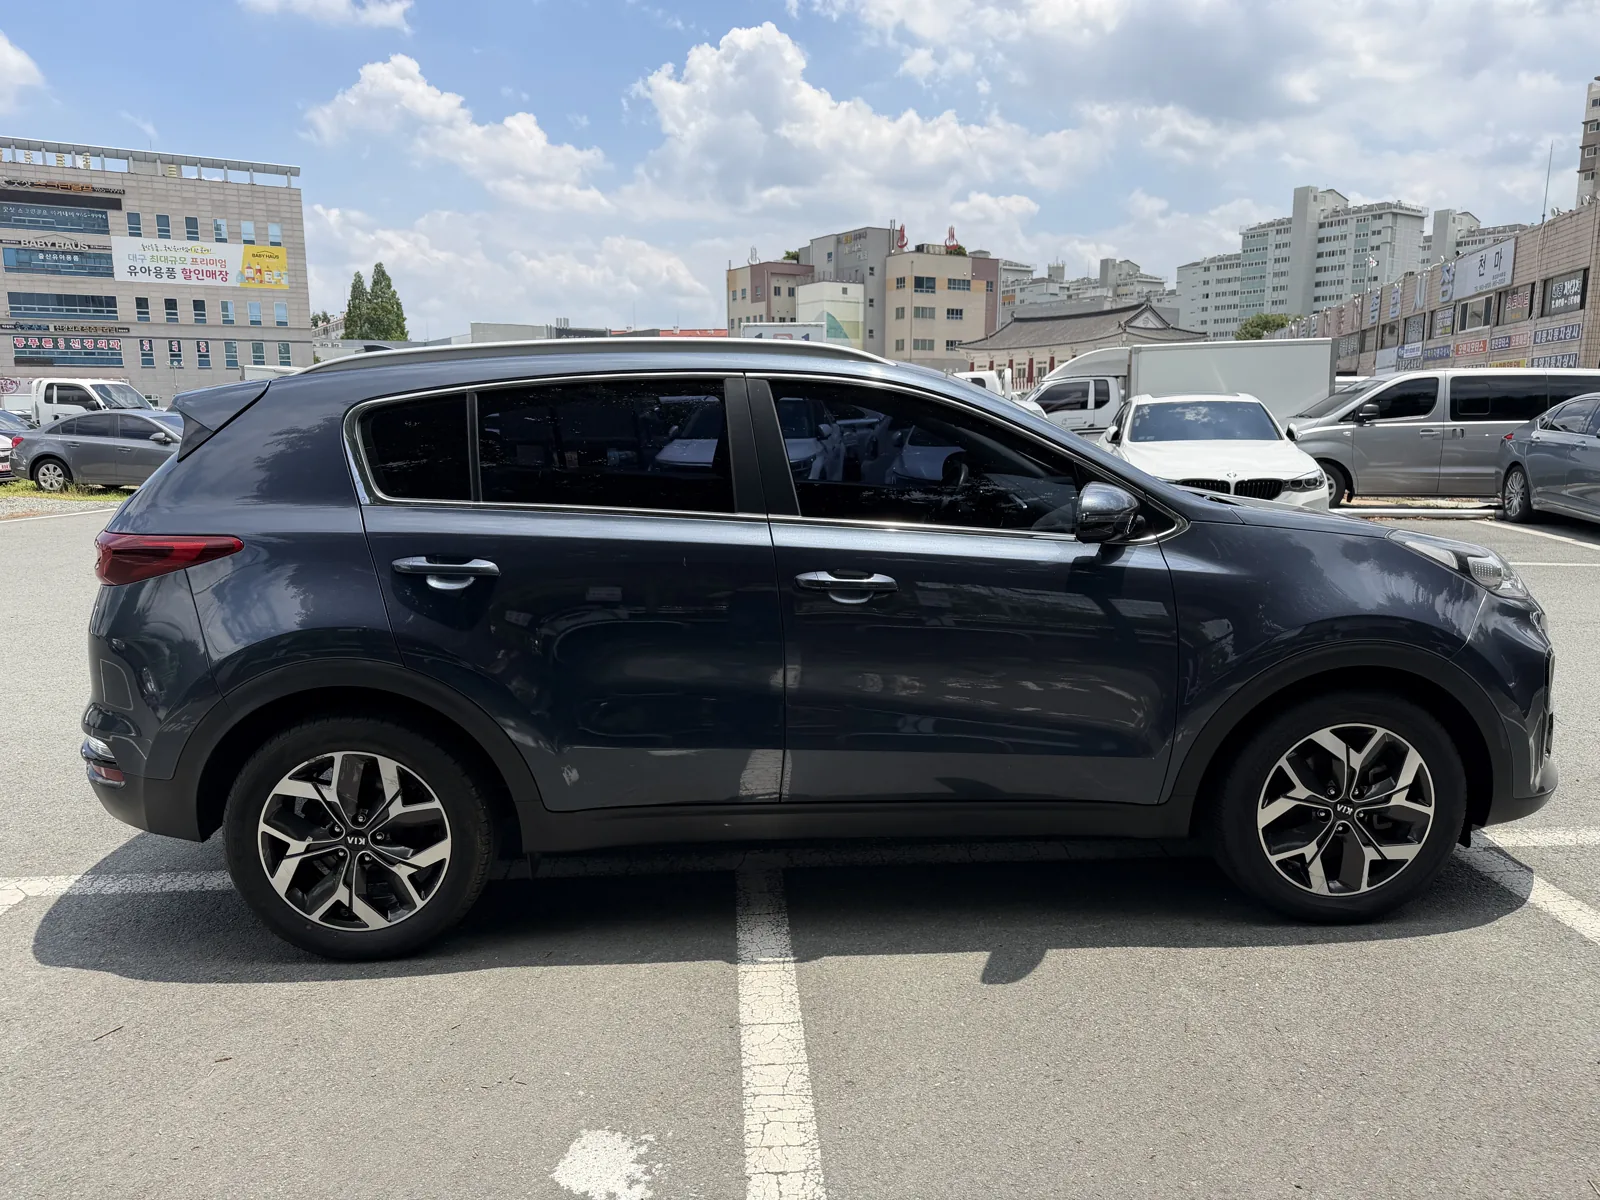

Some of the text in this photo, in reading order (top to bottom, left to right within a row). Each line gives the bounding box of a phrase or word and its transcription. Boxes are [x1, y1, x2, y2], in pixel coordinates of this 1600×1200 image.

[21, 239, 55, 249] BABY
[55, 240, 89, 251] HAUS
[127, 253, 227, 268] 대구 최대규모 프리미엄
[127, 265, 229, 283] 유아용품 할인매장
[1535, 324, 1579, 345] 대동자동차상사
[70, 339, 121, 351] 신경외과
[1336, 804, 1353, 815] KIA
[347, 836, 366, 845] KIA
